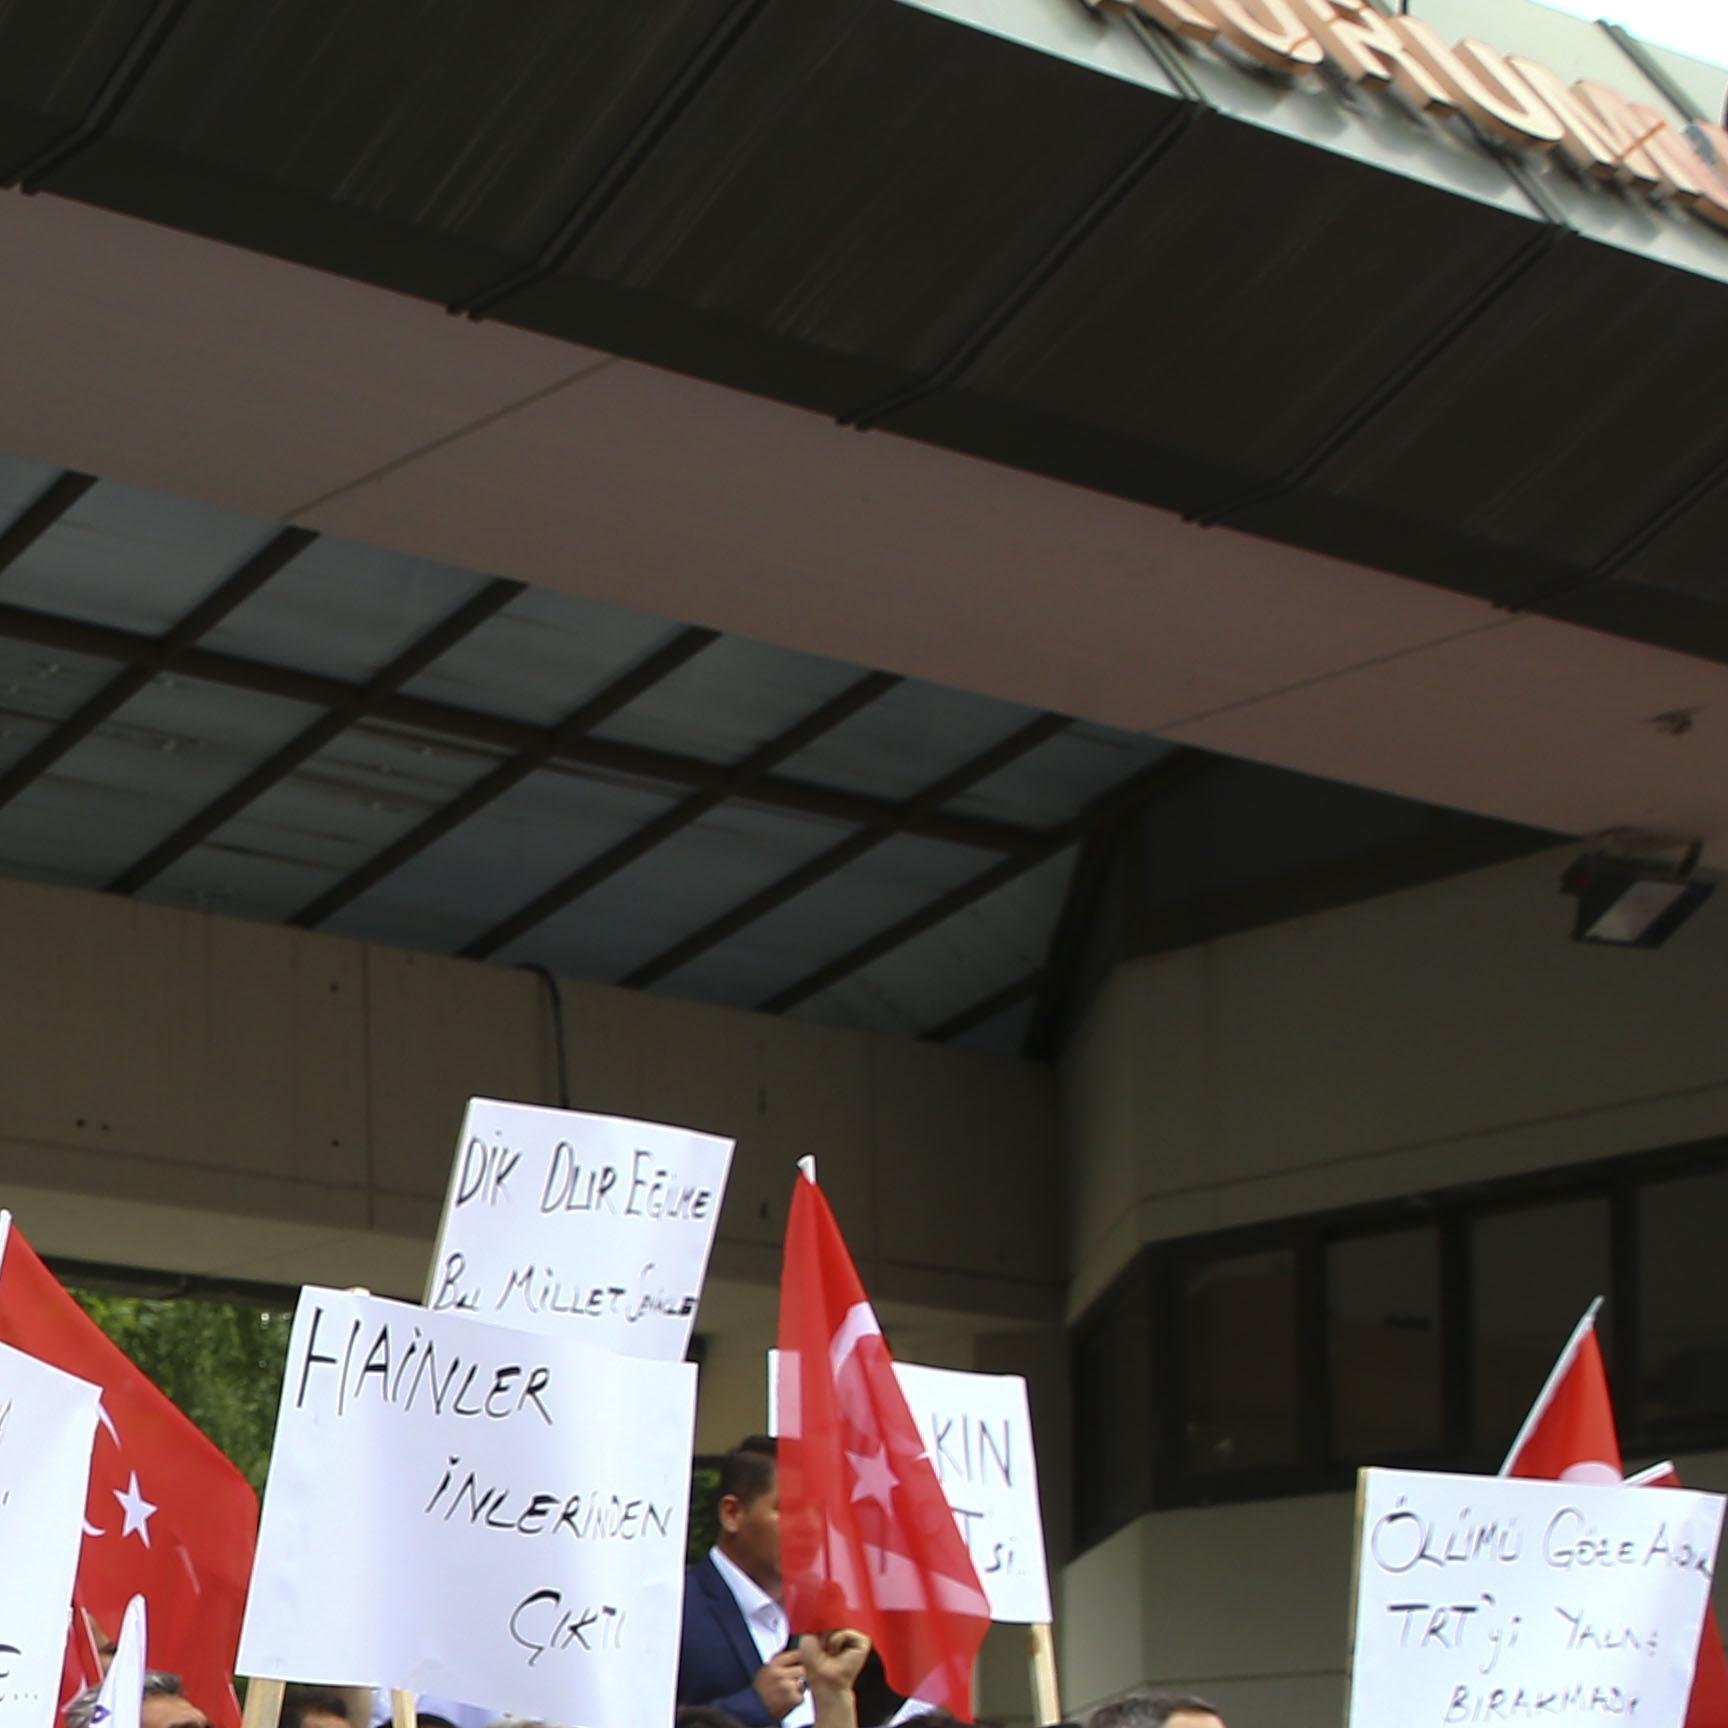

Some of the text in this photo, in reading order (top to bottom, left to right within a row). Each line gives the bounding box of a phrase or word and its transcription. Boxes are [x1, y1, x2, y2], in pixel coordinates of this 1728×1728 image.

[455, 1129, 521, 1207] DİK
[540, 1141, 617, 1214] DUR
[496, 1264, 626, 1317] MİLLET
[296, 1307, 552, 1425] HAİNLER
[425, 1455, 673, 1540] İNLERİNDEN
[509, 1589, 626, 1666] ÇIKTI
